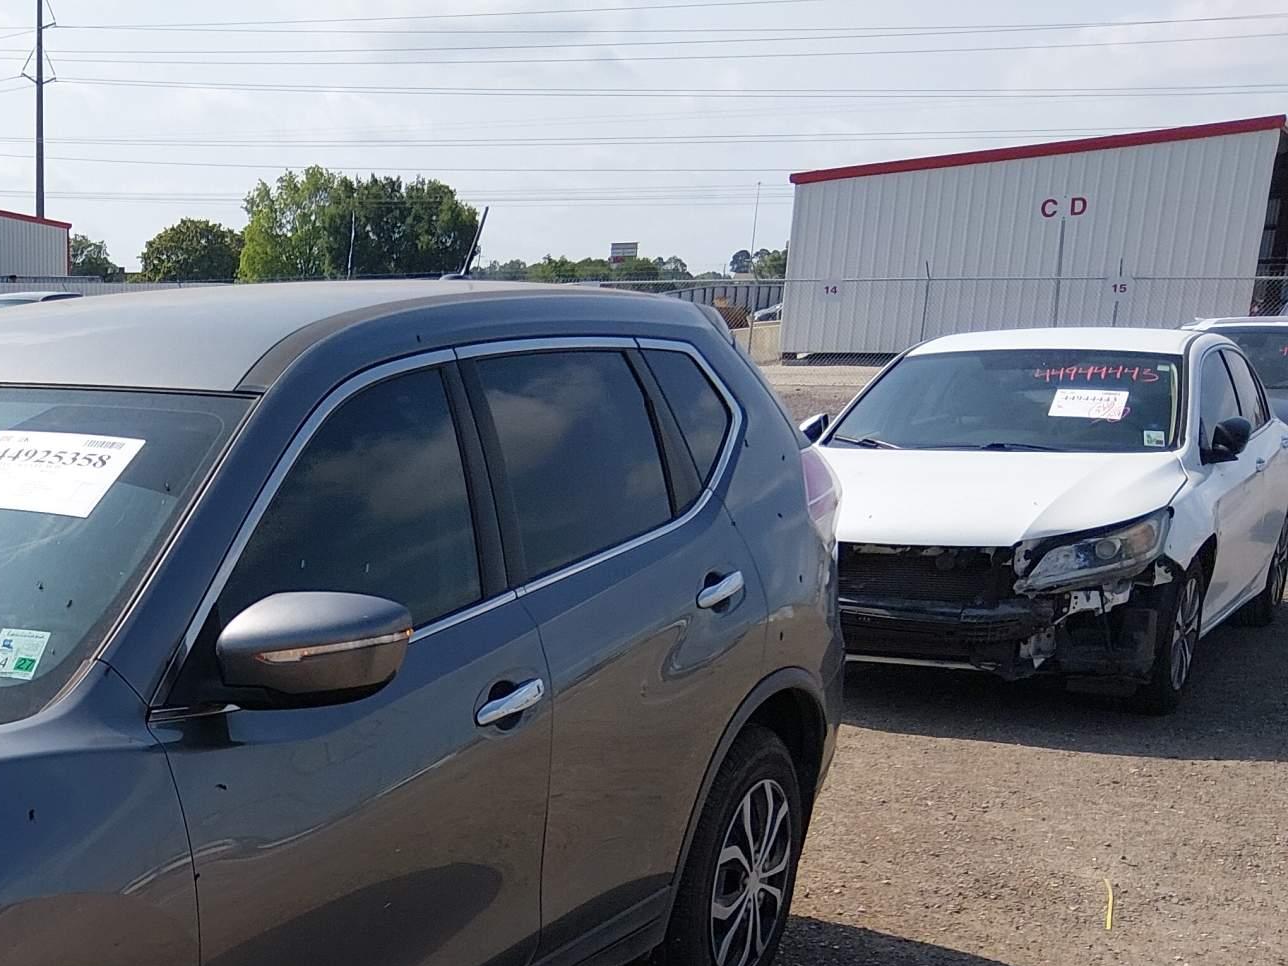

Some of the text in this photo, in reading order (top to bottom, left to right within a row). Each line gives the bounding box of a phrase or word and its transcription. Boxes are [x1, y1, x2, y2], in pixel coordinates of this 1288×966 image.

[1040, 197, 1088, 218] C D
[824, 285, 837, 295] 14
[1112, 283, 1127, 293] 15
[15, 657, 35, 670] 27
